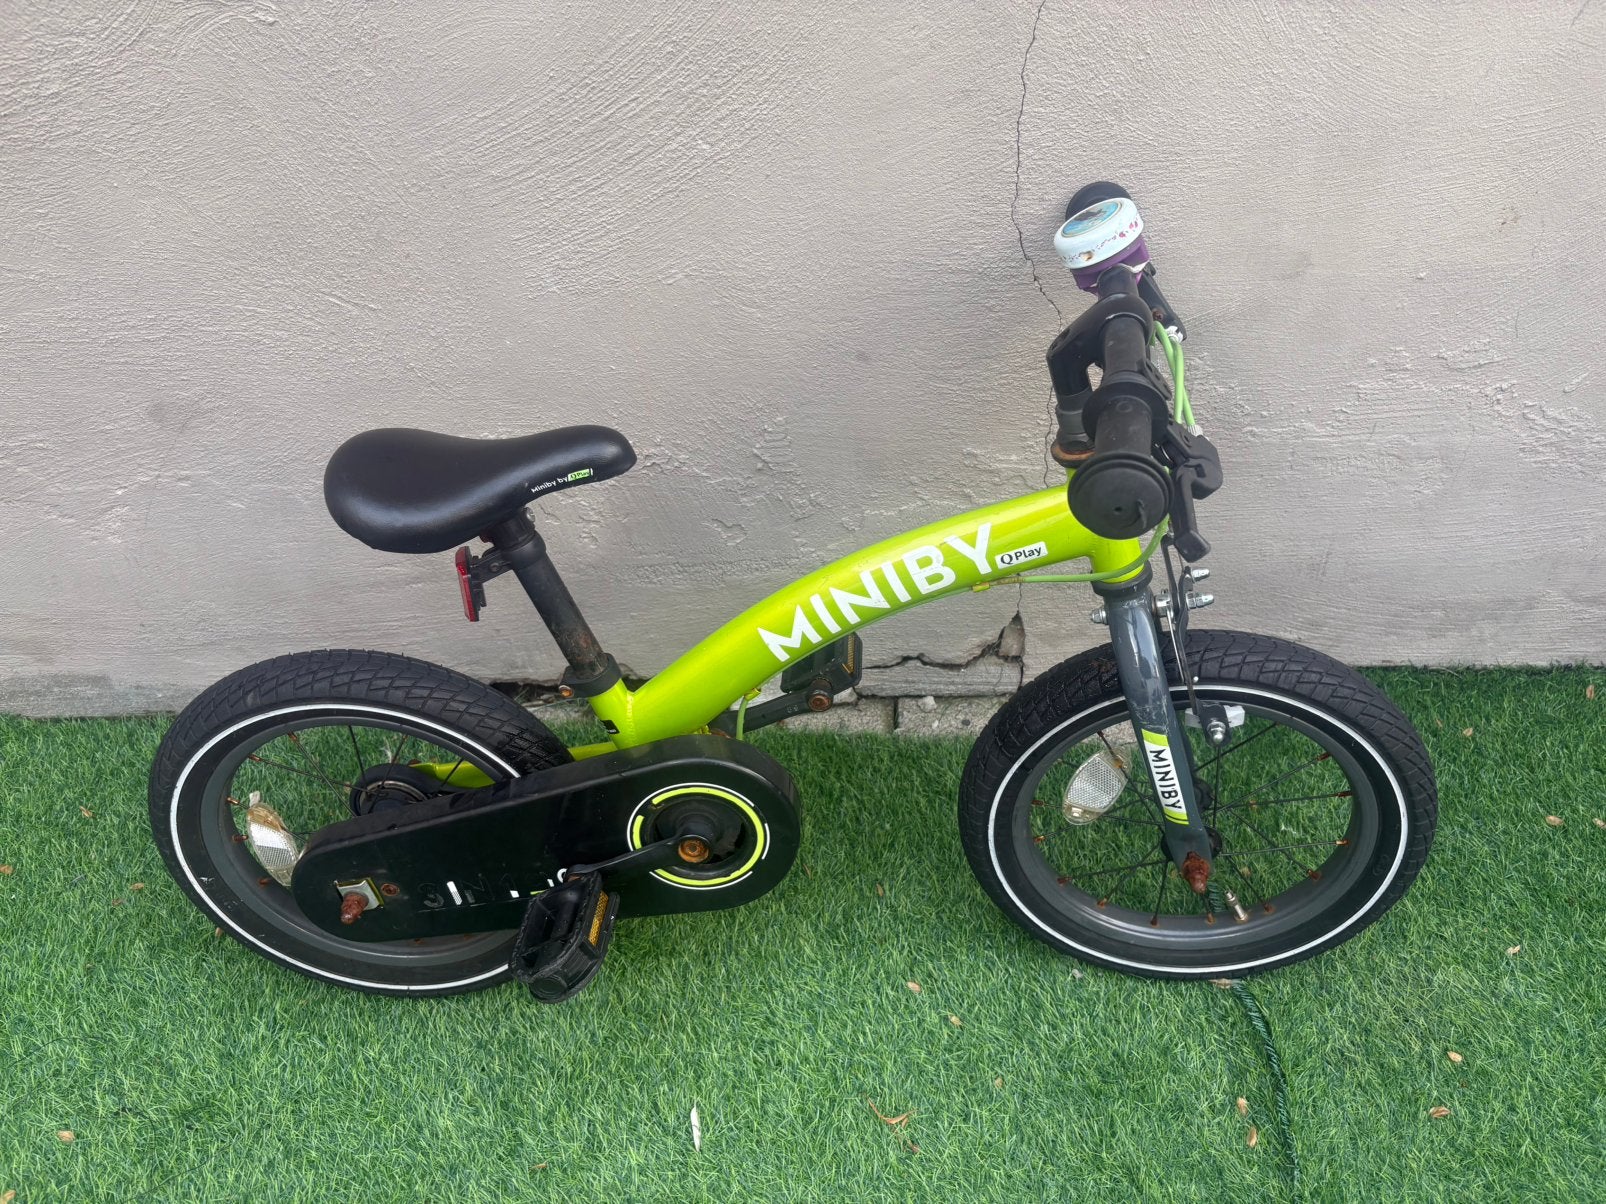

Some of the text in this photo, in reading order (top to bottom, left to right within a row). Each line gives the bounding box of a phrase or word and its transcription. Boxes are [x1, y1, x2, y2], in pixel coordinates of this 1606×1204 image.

[531, 480, 557, 492] Miniby
[757, 522, 992, 662] MINIBY
[1149, 748, 1183, 810] MINIBY
